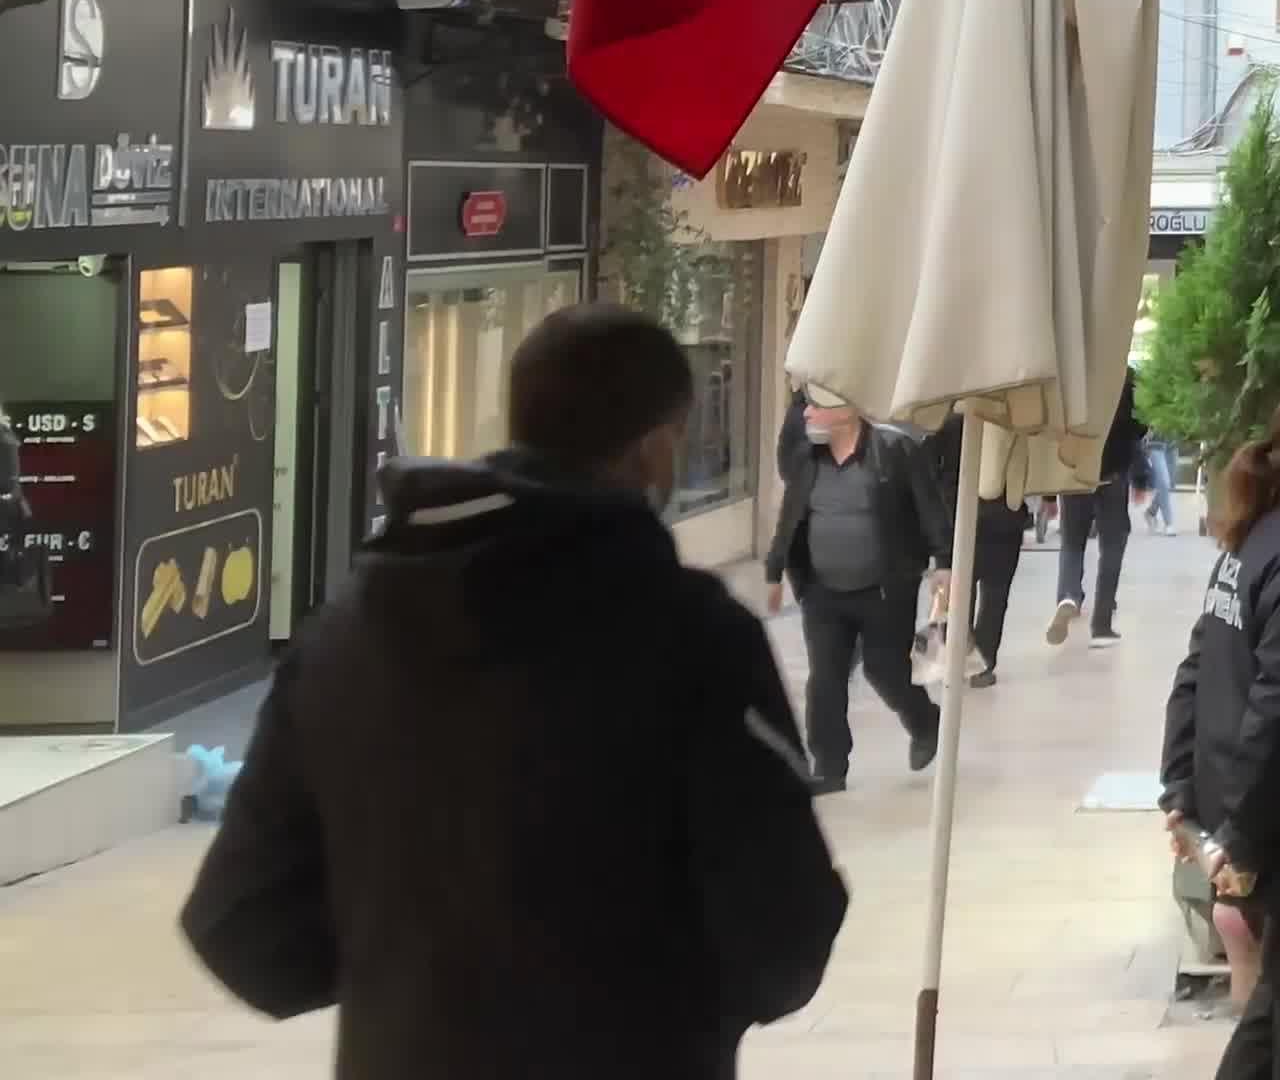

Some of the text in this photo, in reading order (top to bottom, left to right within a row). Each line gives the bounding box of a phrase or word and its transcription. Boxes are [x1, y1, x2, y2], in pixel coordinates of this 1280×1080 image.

[271, 40, 392, 126] TURAN
[206, 176, 389, 222] INTERNATIONAL
[28, 414, 66, 431] USD
[173, 465, 236, 512] TURAN
